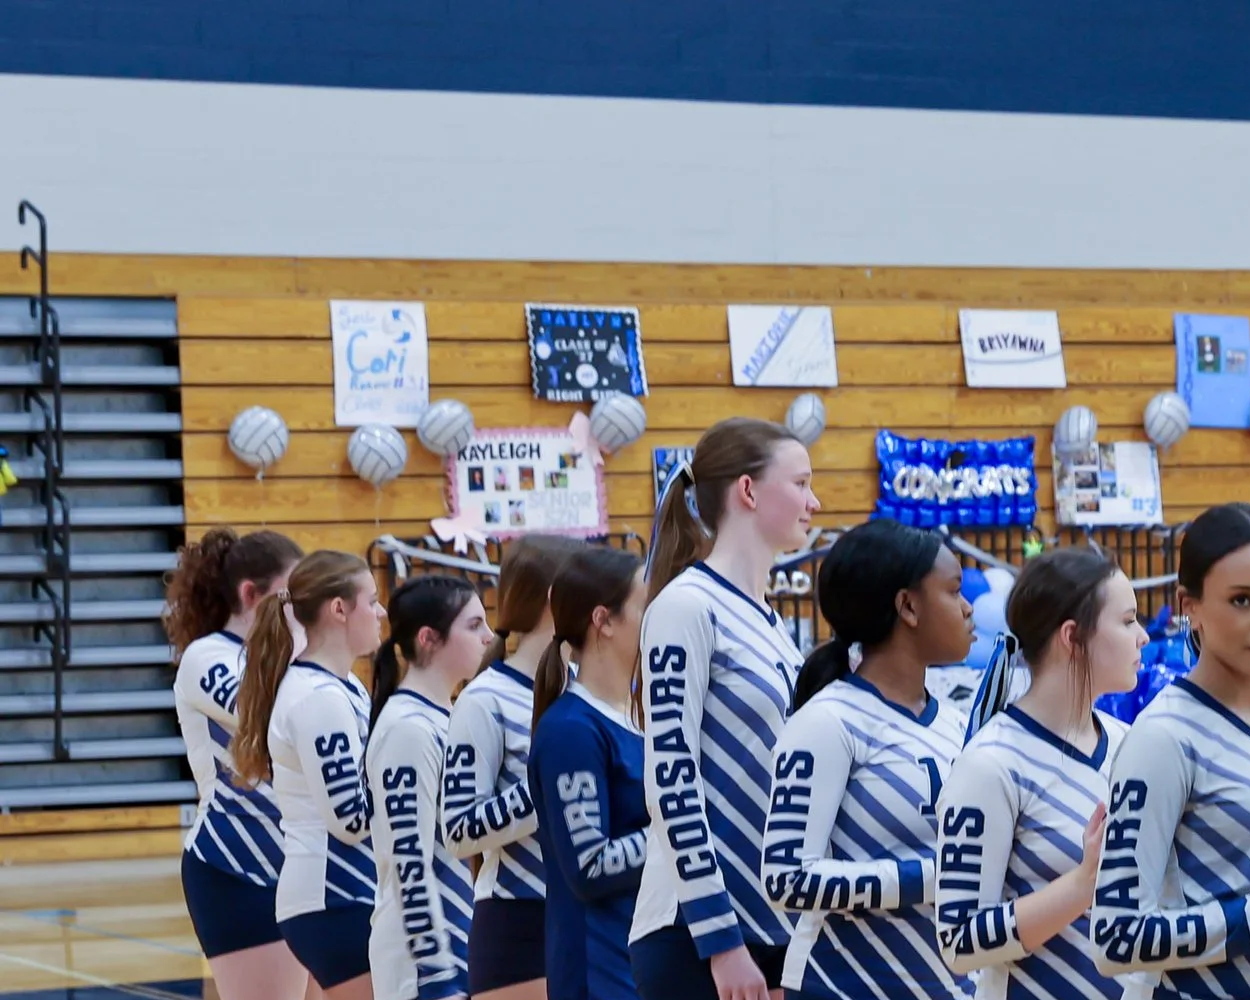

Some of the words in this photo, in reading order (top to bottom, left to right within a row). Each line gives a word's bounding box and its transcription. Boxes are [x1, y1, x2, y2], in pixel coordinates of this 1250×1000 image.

[346, 328, 407, 373] Cori
[457, 442, 541, 461] KAYLEIGH
[893, 463, 1030, 504] CONGRATS
[650, 644, 718, 882] CORSAIRS
[382, 765, 439, 958] CORSAIRS
[1095, 779, 1207, 963] CORSAIRS
